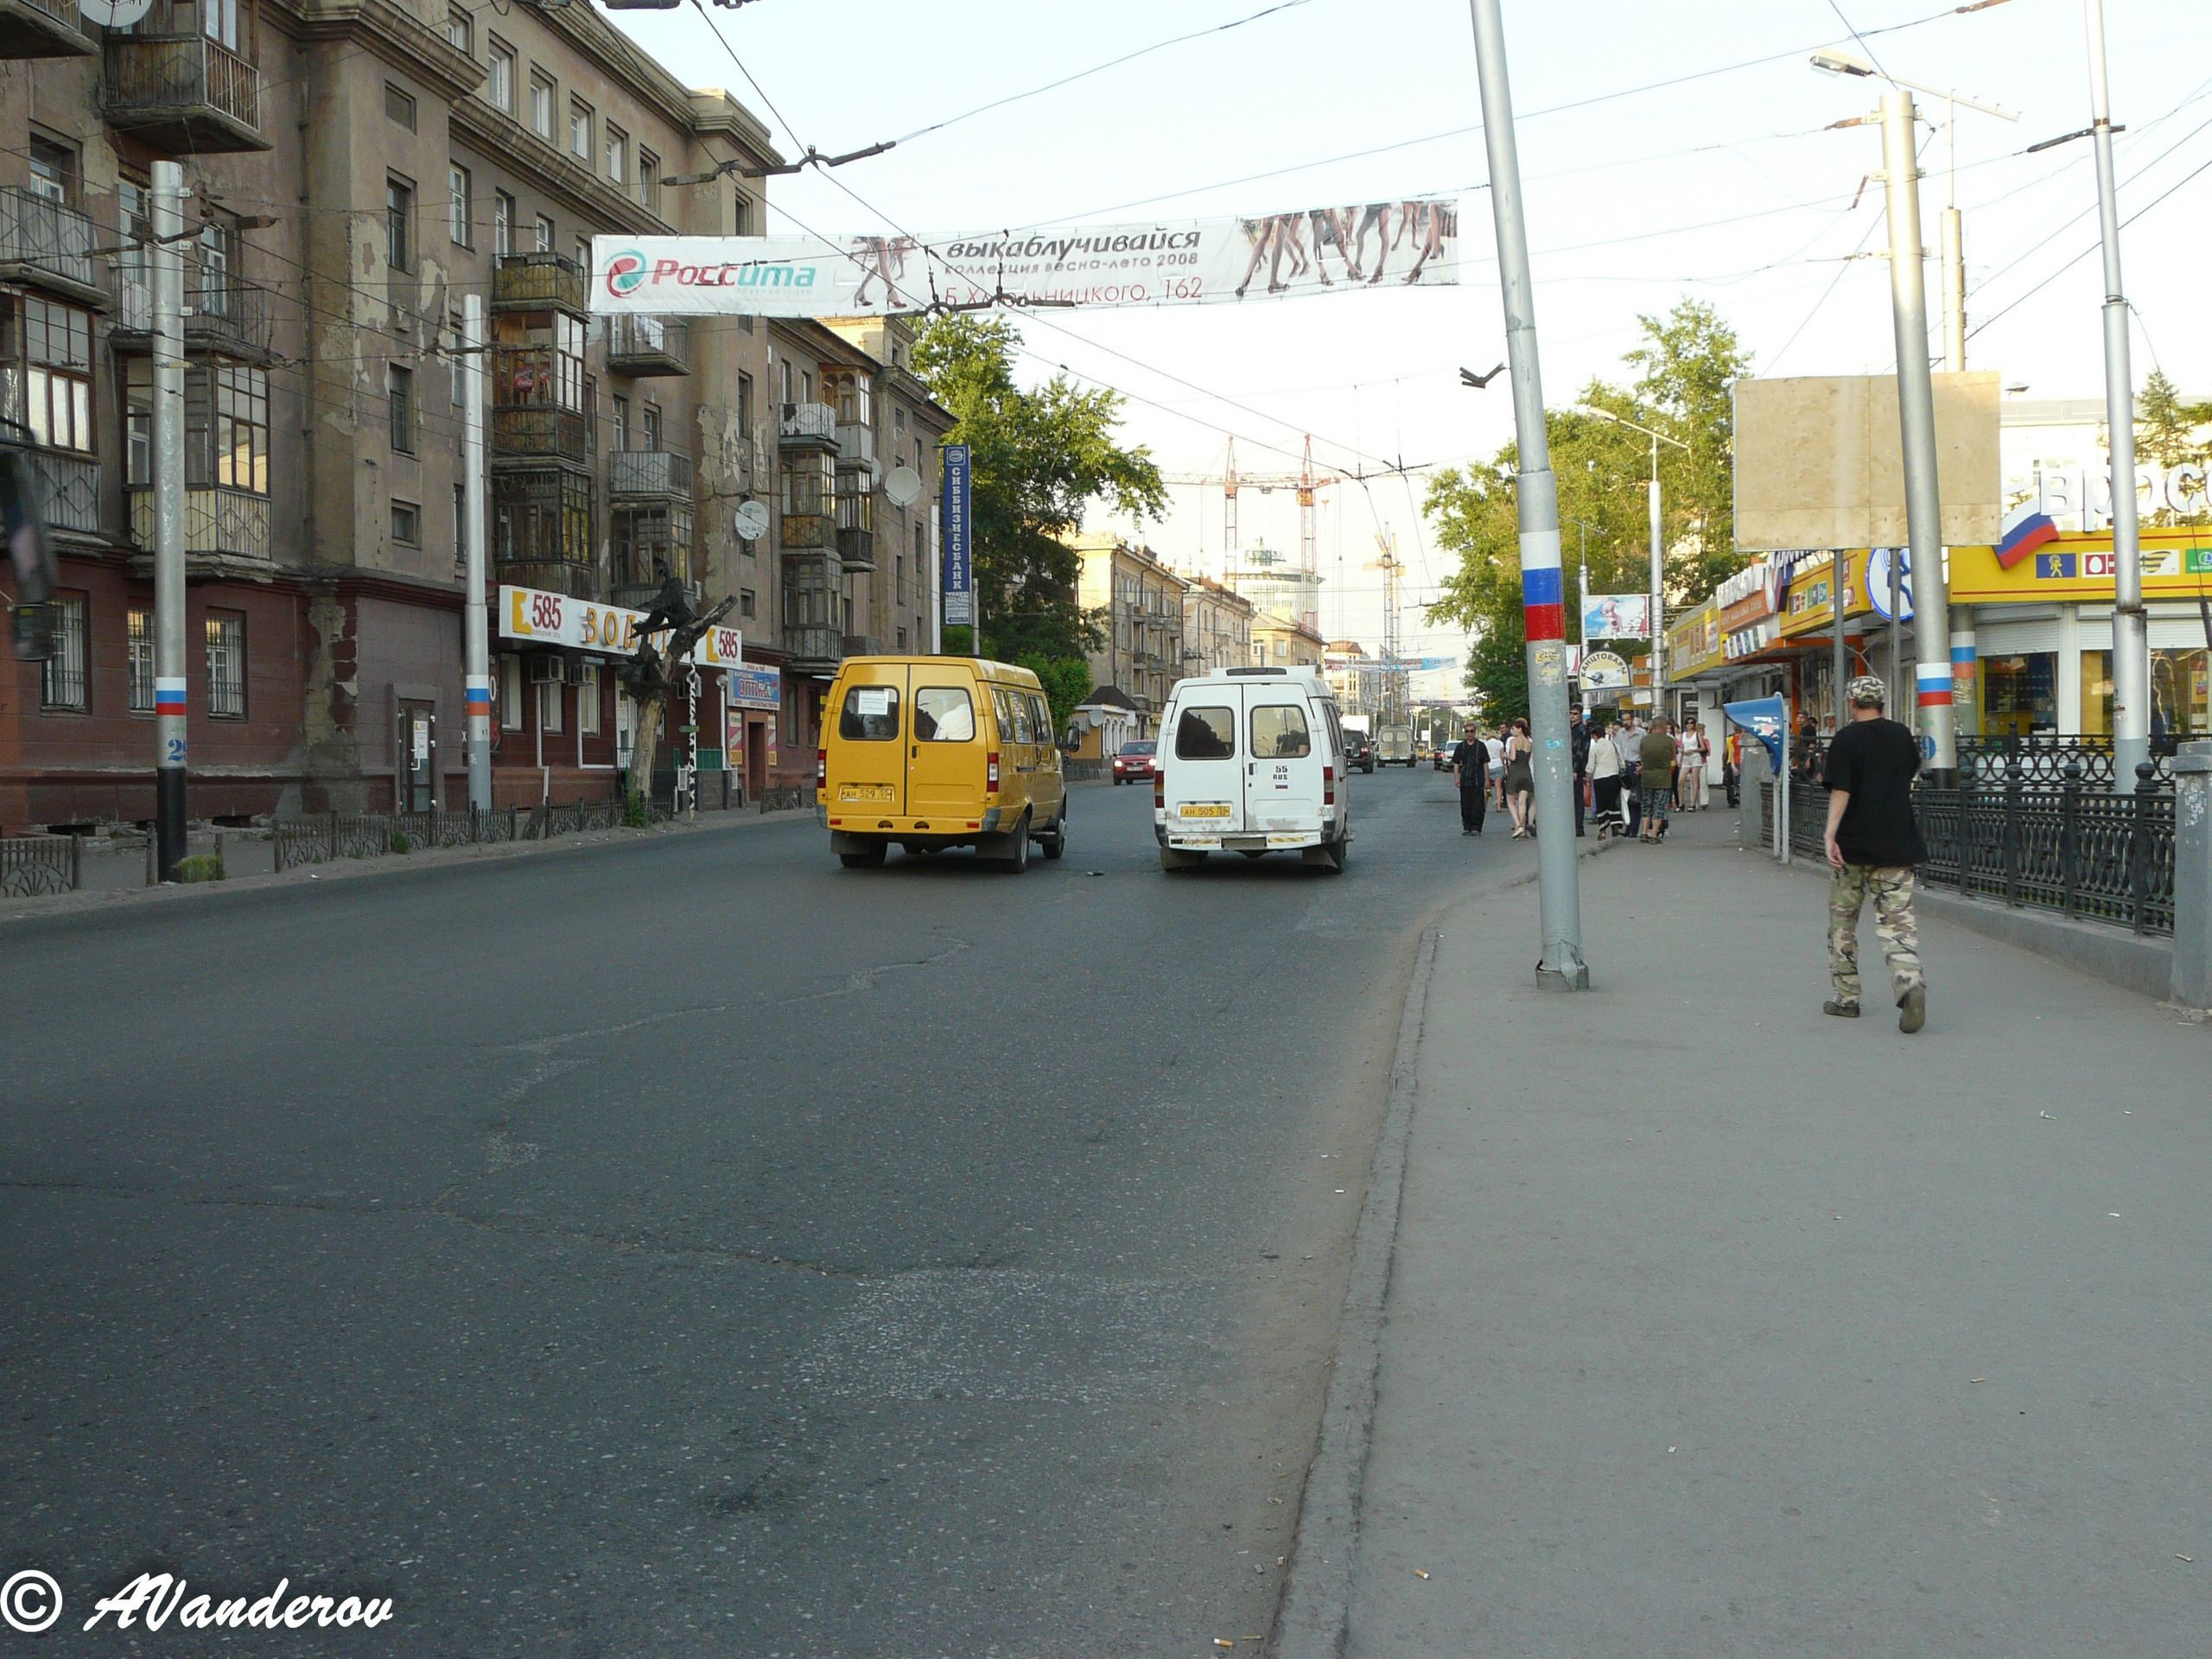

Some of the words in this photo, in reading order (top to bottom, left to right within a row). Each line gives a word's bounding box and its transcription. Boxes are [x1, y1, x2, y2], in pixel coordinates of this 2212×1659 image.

[947, 228, 1201, 260] выкаблучивайся
[945, 263, 1039, 275] коллекция
[1045, 257, 1151, 272] весна-лето
[1157, 252, 1198, 267] 2008
[945, 287, 957, 307] Б
[967, 284, 1152, 307] ХМЛЬНИЦКОГО,
[1166, 276, 1202, 299] 162
[951, 467, 963, 589] СИББИЗНЕСБАНК
[532, 594, 562, 630] 585
[585, 607, 671, 654] ЗОЛТ
[719, 630, 738, 658] 585
[1580, 652, 1628, 677] КАНЦТОВАРЫ
[738, 678, 772, 700] ОПТИКА
